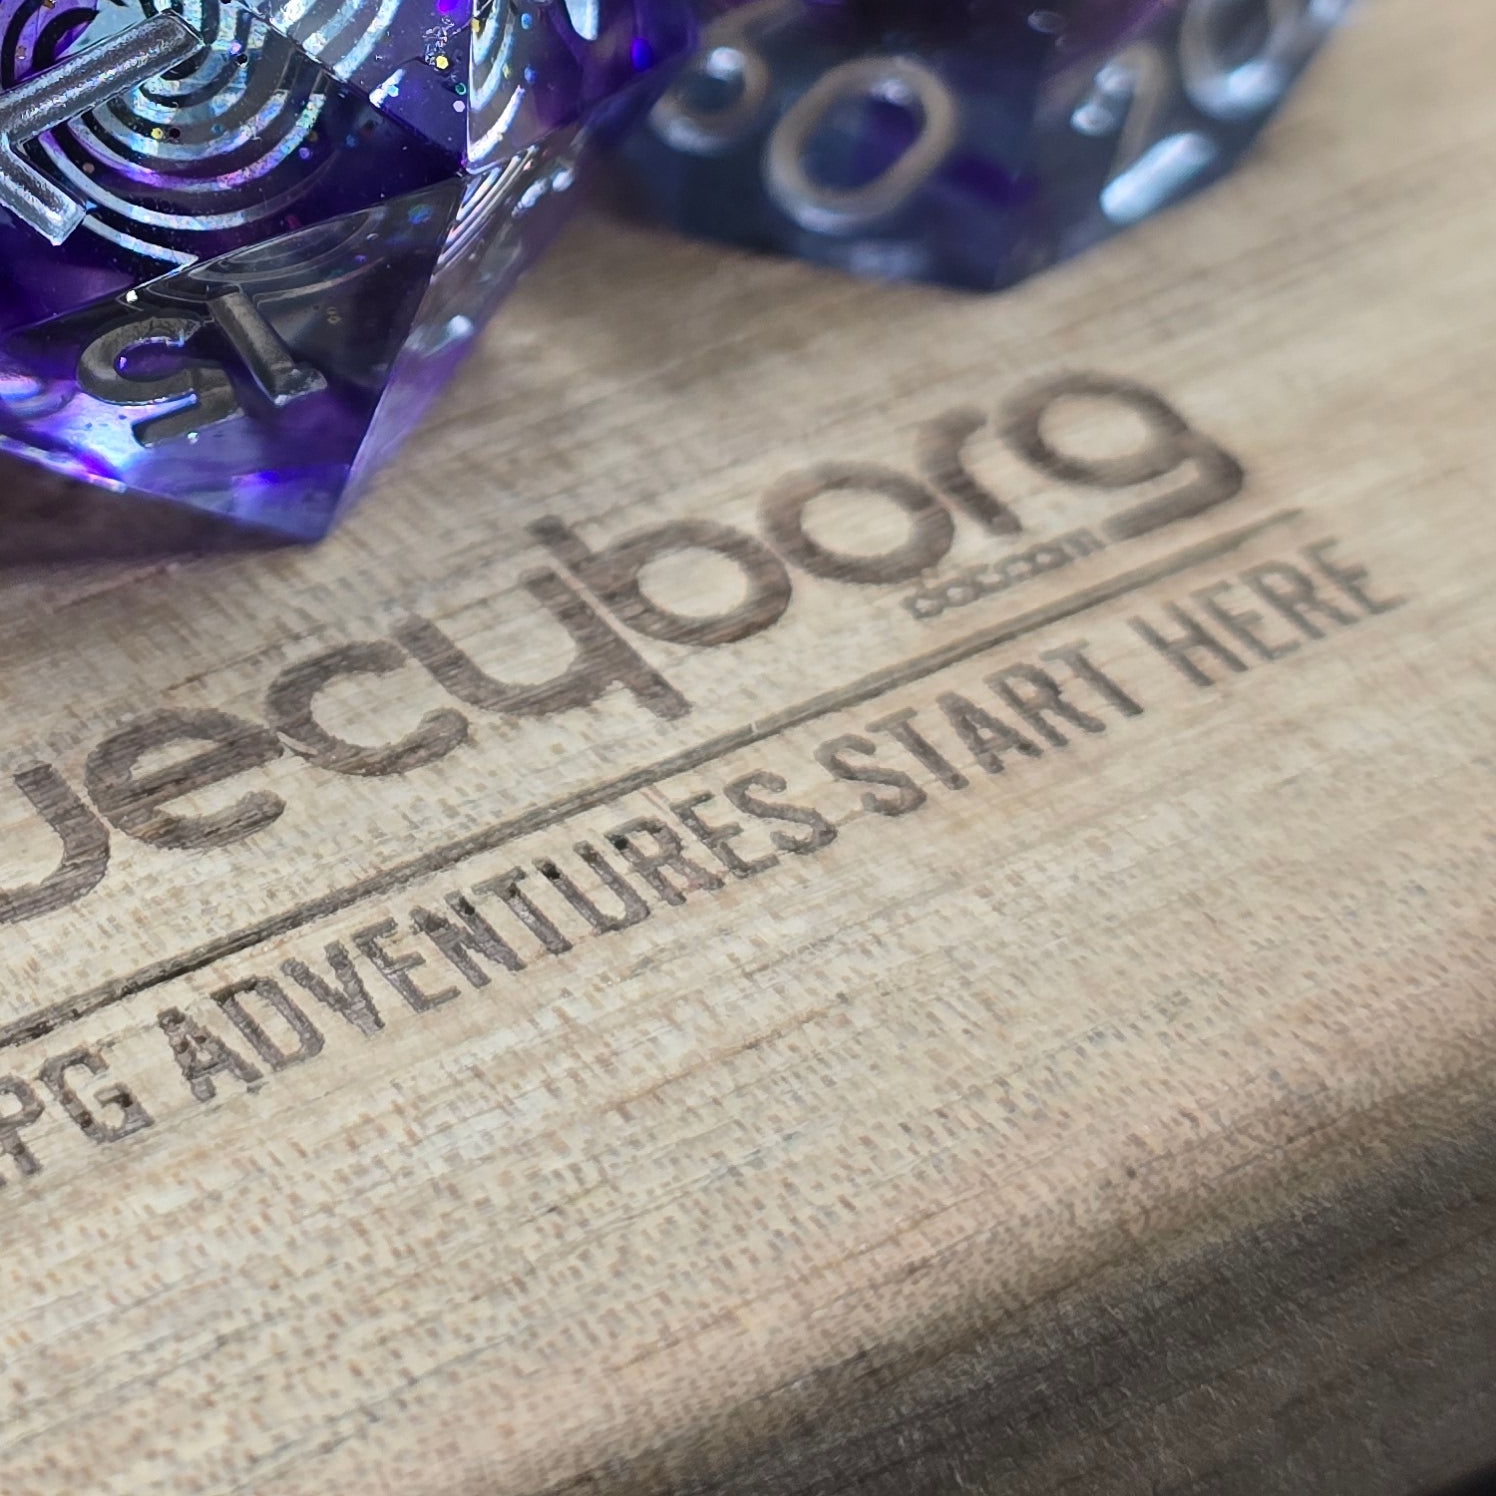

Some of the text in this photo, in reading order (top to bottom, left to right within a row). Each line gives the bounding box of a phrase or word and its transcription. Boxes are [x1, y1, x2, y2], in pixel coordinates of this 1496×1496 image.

[76, 287, 329, 449] 15
[156, 769, 838, 1103] ADVENTURES
[812, 638, 1144, 818] START
[1128, 535, 1408, 688] HERE
